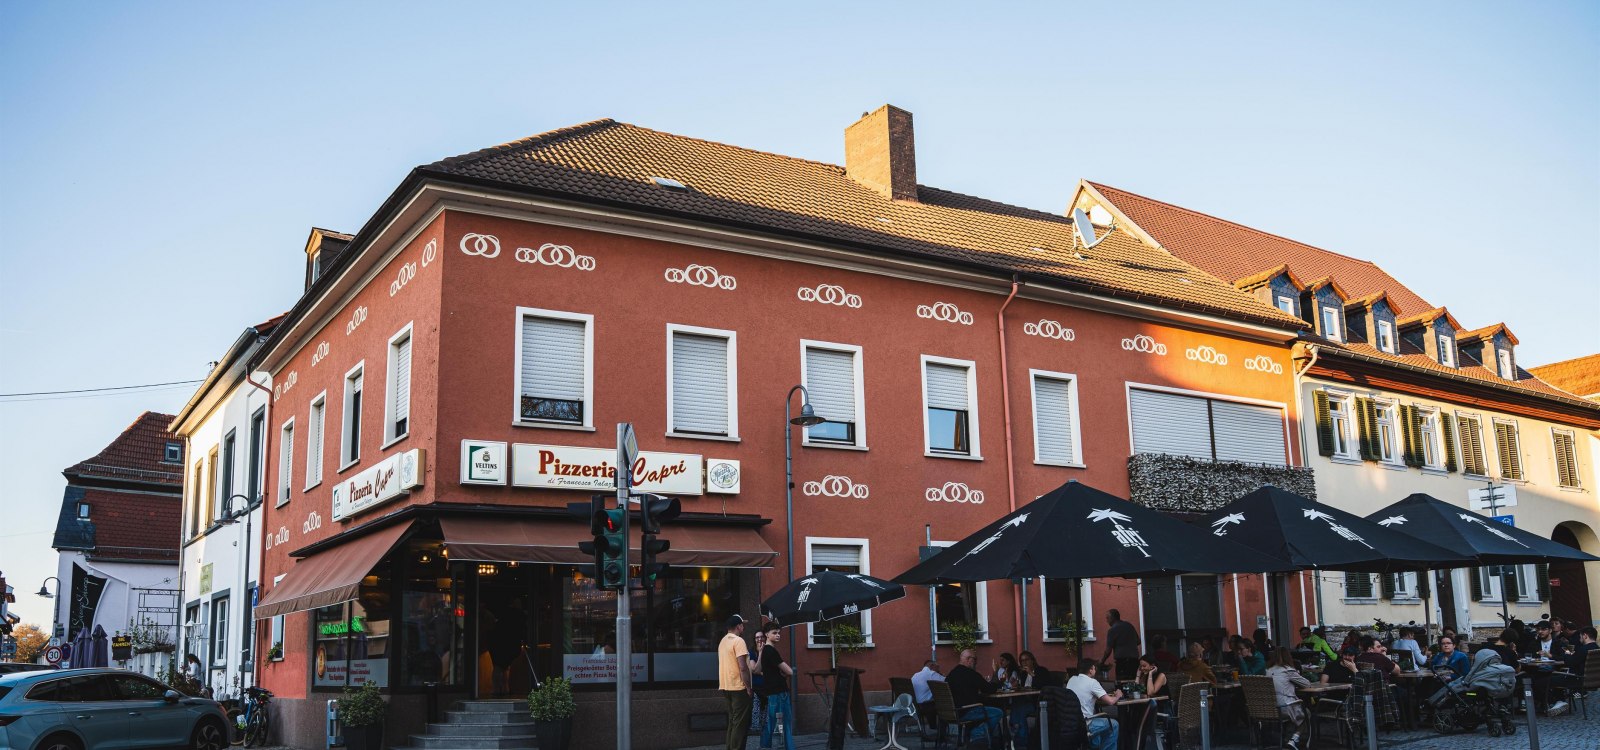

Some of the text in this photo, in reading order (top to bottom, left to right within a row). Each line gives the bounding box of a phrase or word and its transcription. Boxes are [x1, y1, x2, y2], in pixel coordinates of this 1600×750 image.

[475, 462, 497, 470] VELTINS
[539, 450, 617, 478] Pizzeria
[632, 458, 686, 487] Capri
[350, 481, 373, 503] Pizzeria
[375, 463, 394, 499] Capri
[557, 477, 592, 486] Francesco
[48, 650, 59, 660] 30
